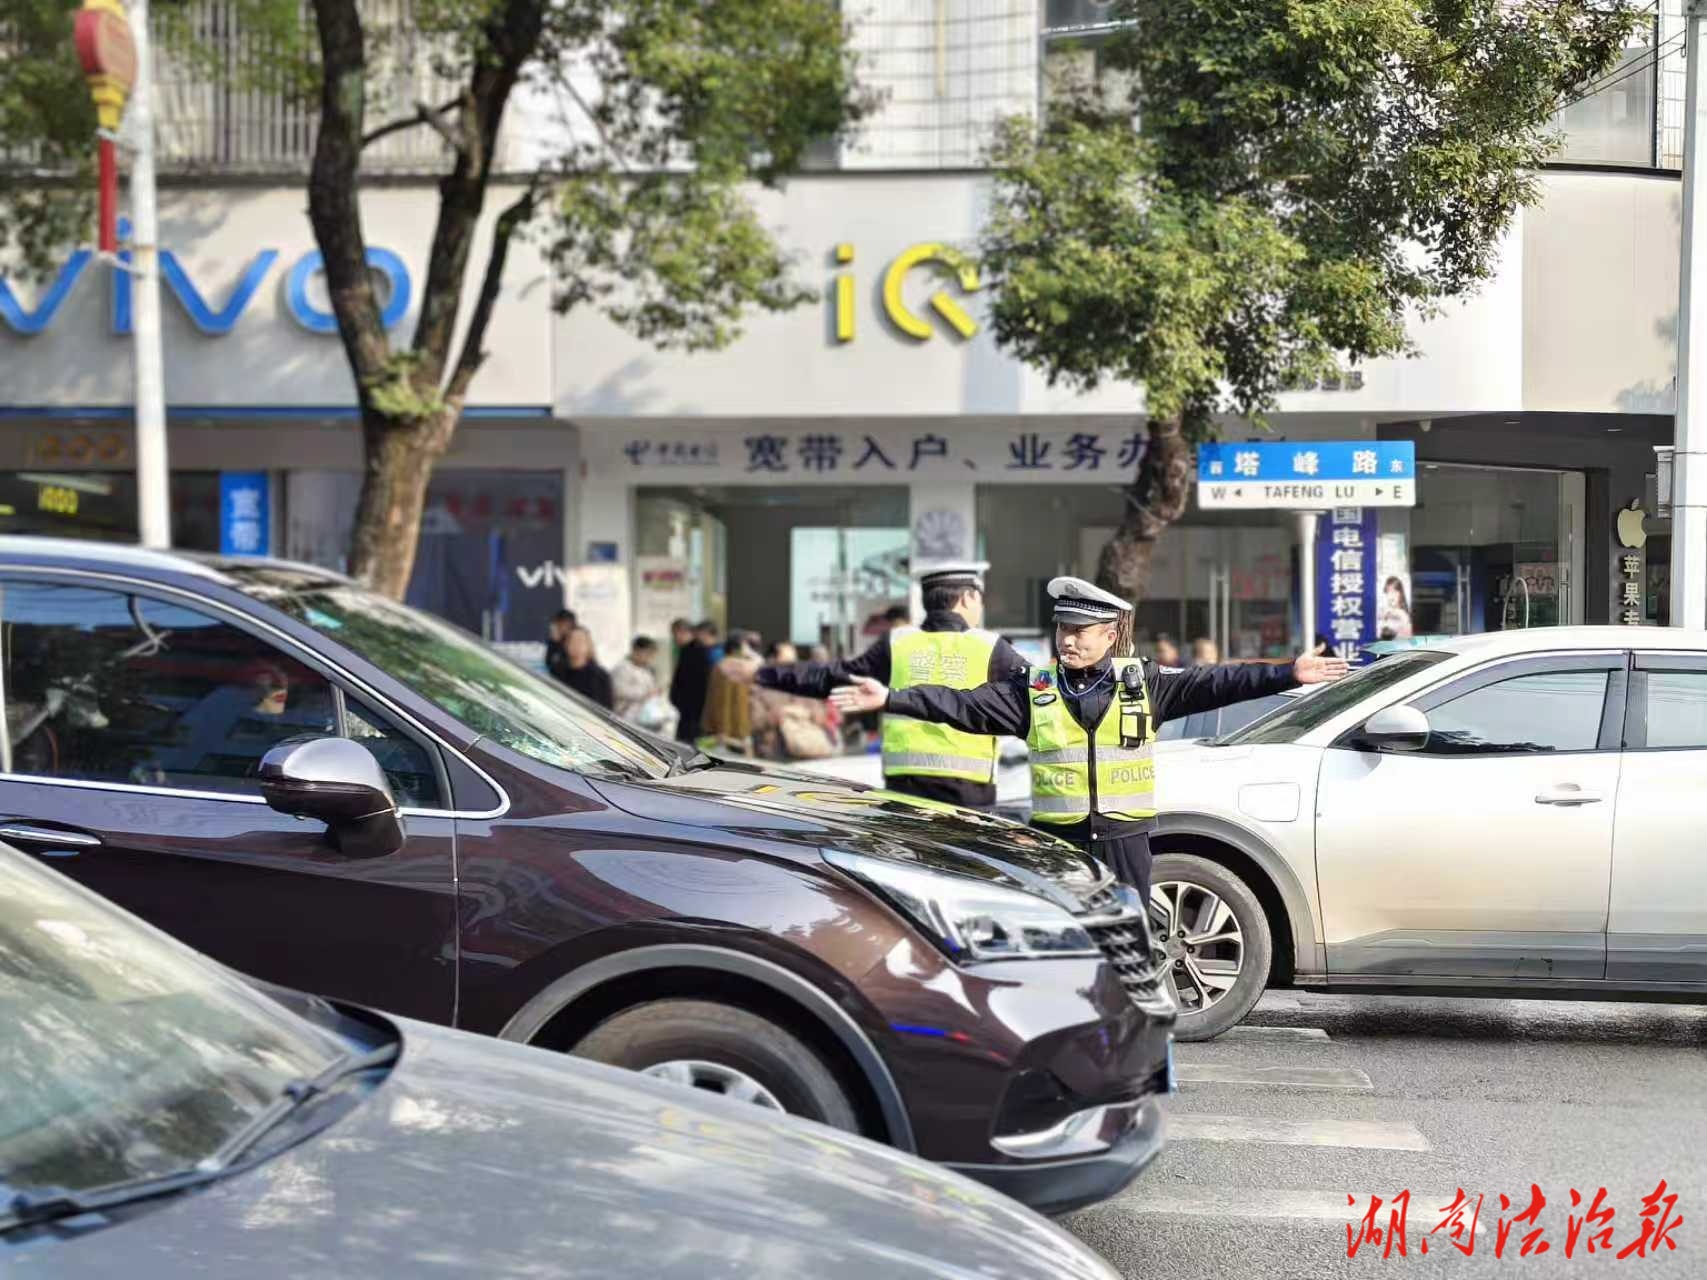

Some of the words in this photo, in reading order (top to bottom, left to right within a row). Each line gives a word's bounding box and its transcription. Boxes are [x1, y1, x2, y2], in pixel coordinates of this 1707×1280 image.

[0, 217, 412, 334] vivo
[1211, 487, 1227, 500] W
[1264, 485, 1324, 498] TAFENG
[1335, 485, 1355, 498] LU
[1393, 486, 1403, 499] E
[1234, 449, 1378, 476] 塔峰路
[1329, 507, 1365, 669] 国电信授权营业
